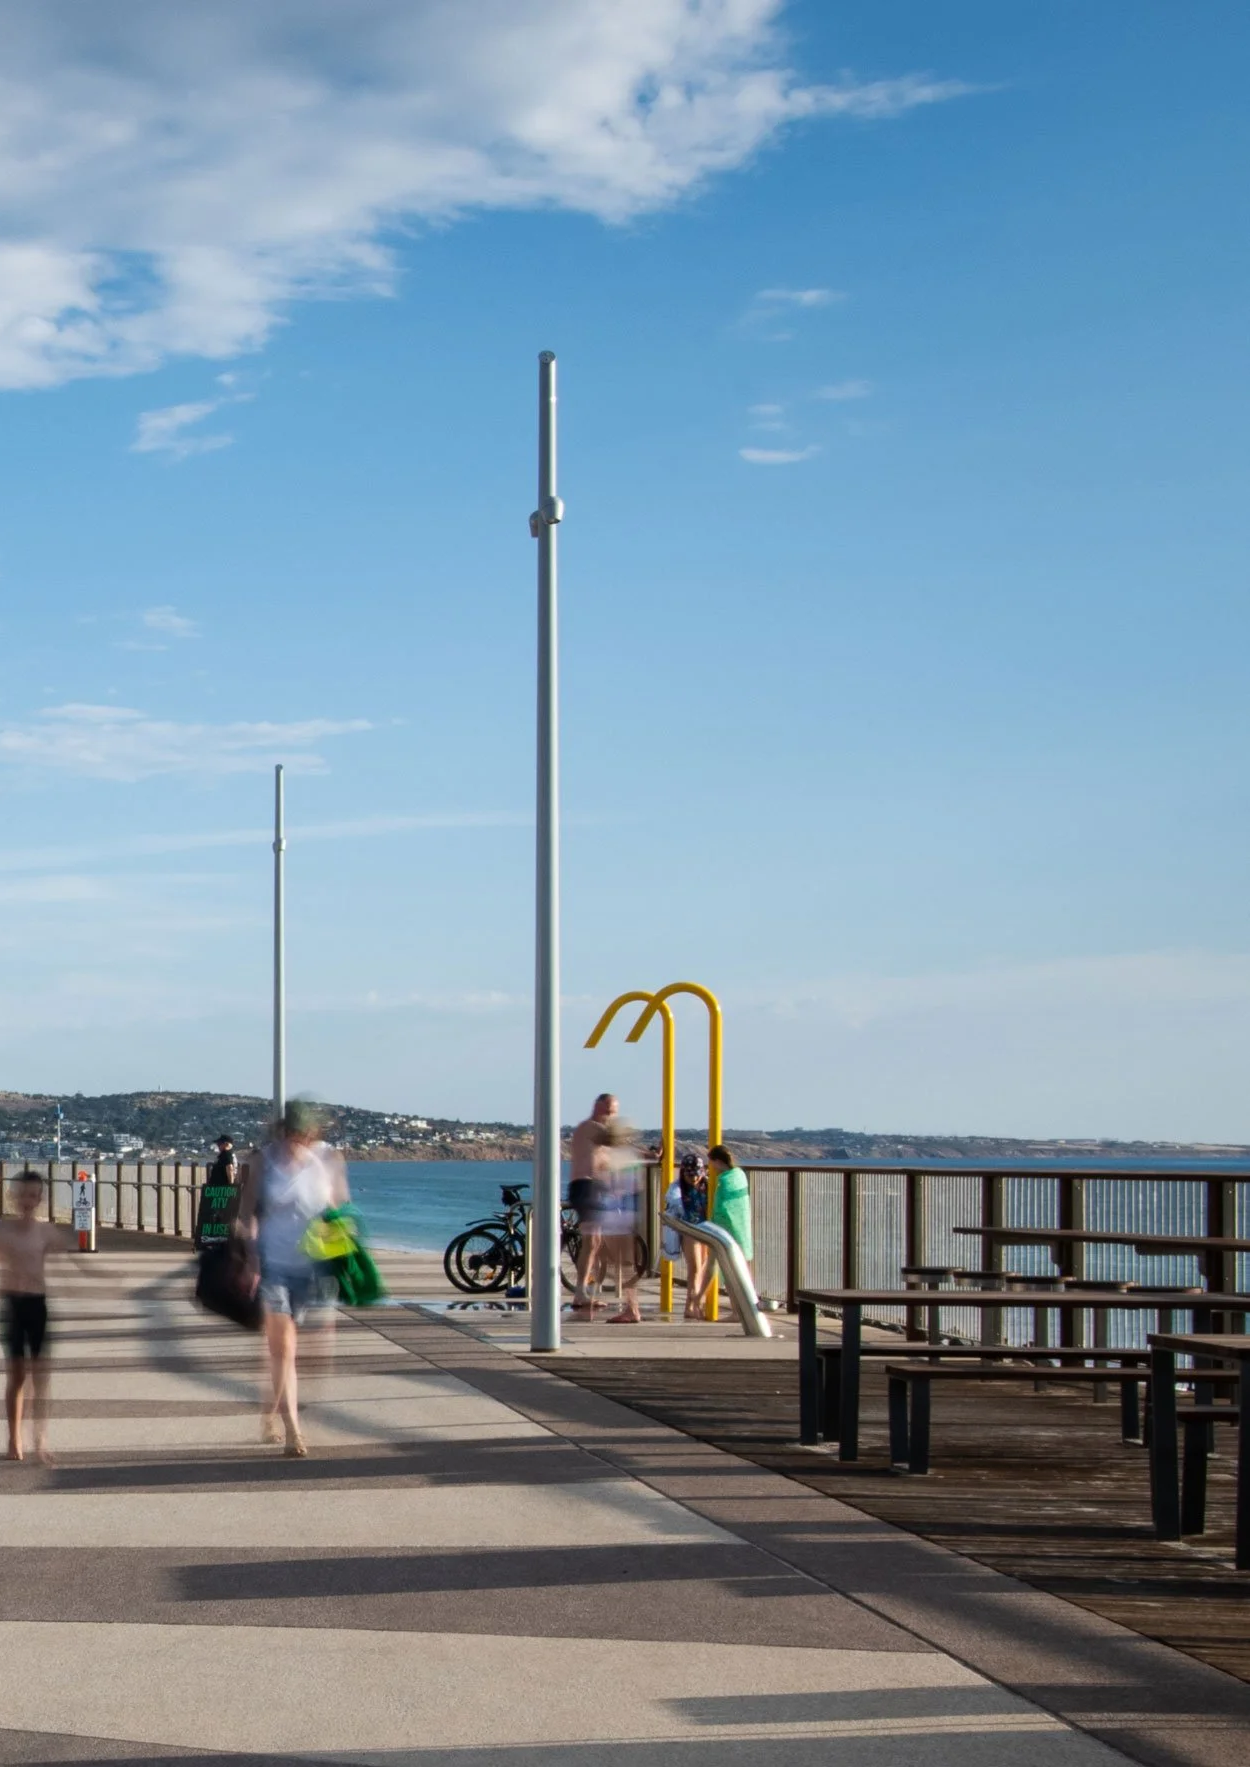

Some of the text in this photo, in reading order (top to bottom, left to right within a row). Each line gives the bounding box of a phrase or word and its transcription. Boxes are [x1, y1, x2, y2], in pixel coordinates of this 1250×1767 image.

[205, 1186, 238, 1198] CAUTION
[211, 1198, 228, 1209] ATV
[202, 1223, 230, 1235] IN USE
